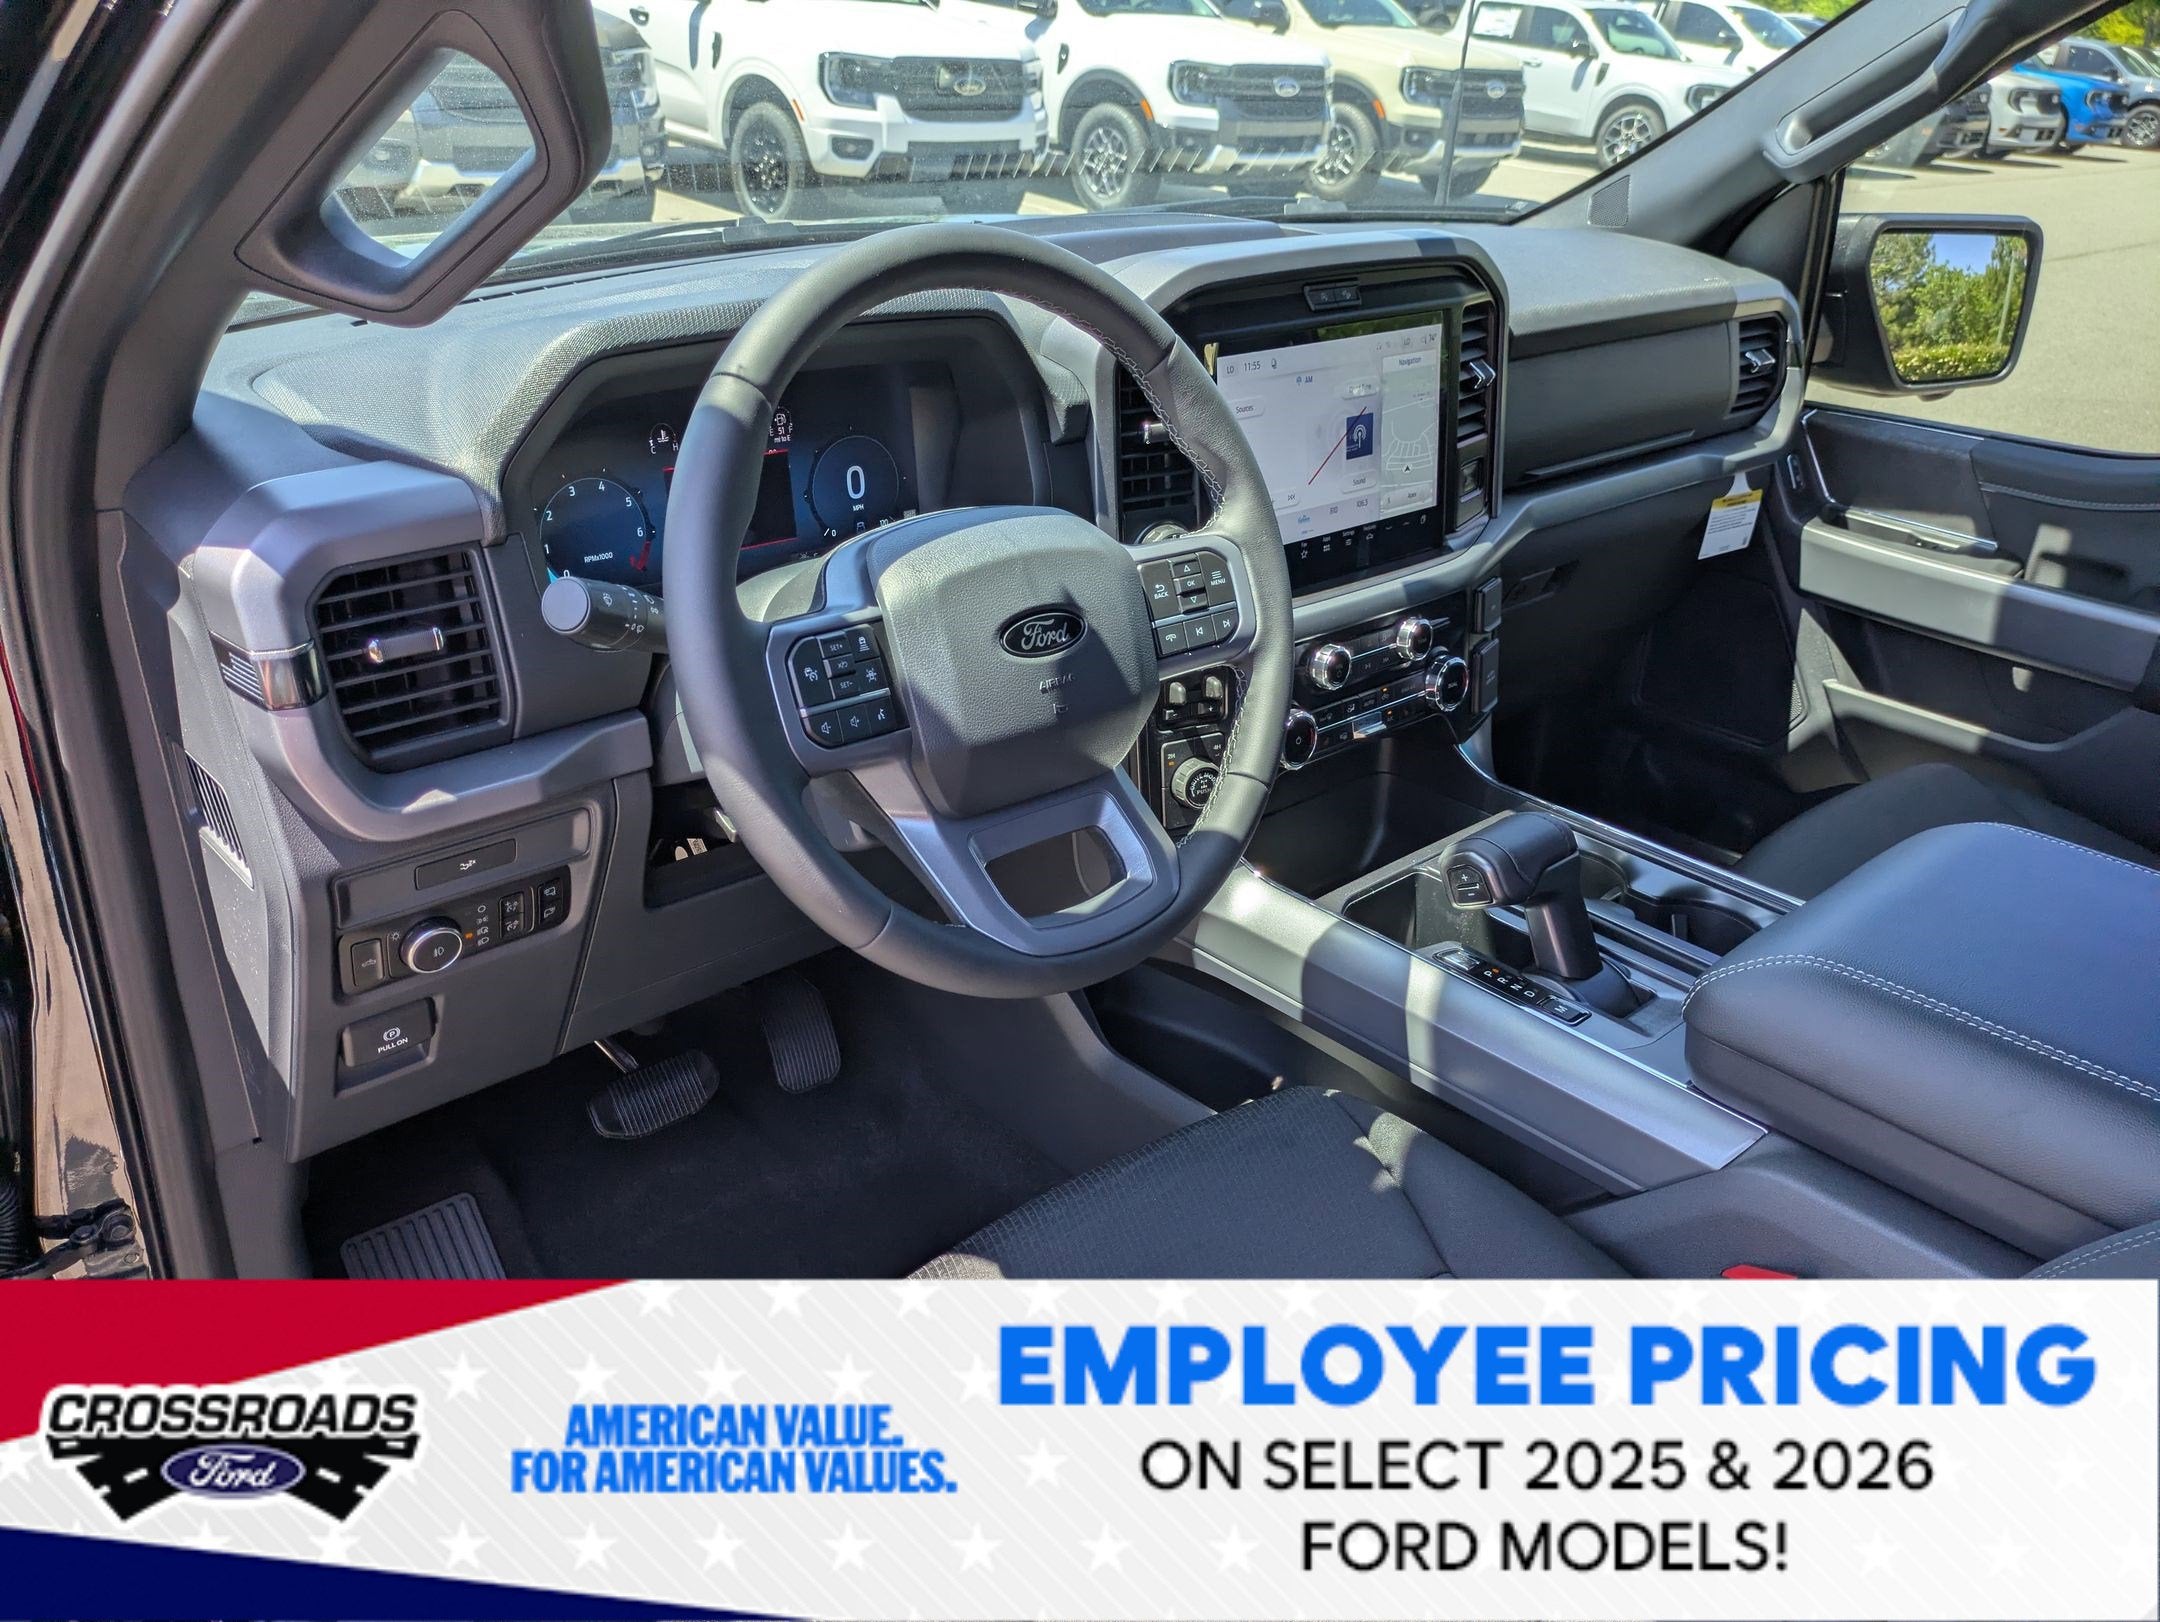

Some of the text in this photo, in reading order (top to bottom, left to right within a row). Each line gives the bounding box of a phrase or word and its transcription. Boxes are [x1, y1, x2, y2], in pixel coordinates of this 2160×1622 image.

[1244, 361, 1261, 372] 11:55
[777, 427, 785, 436] 51
[598, 481, 605, 491] 4
[846, 465, 866, 500] 0
[568, 486, 576, 497] 3
[625, 497, 632, 507] 5
[853, 504, 865, 512] MPH
[546, 510, 553, 521] 2
[637, 527, 644, 537] 6
[831, 529, 837, 537] 0
[544, 543, 550, 554] 1
[584, 552, 613, 563] RPMx1000
[1210, 578, 1226, 587] MENU
[1154, 591, 1169, 600] BACK
[1021, 618, 1071, 651] Ford
[1483, 970, 1493, 978] P
[1497, 976, 1508, 985] R
[377, 1036, 409, 1053] PULL ON
